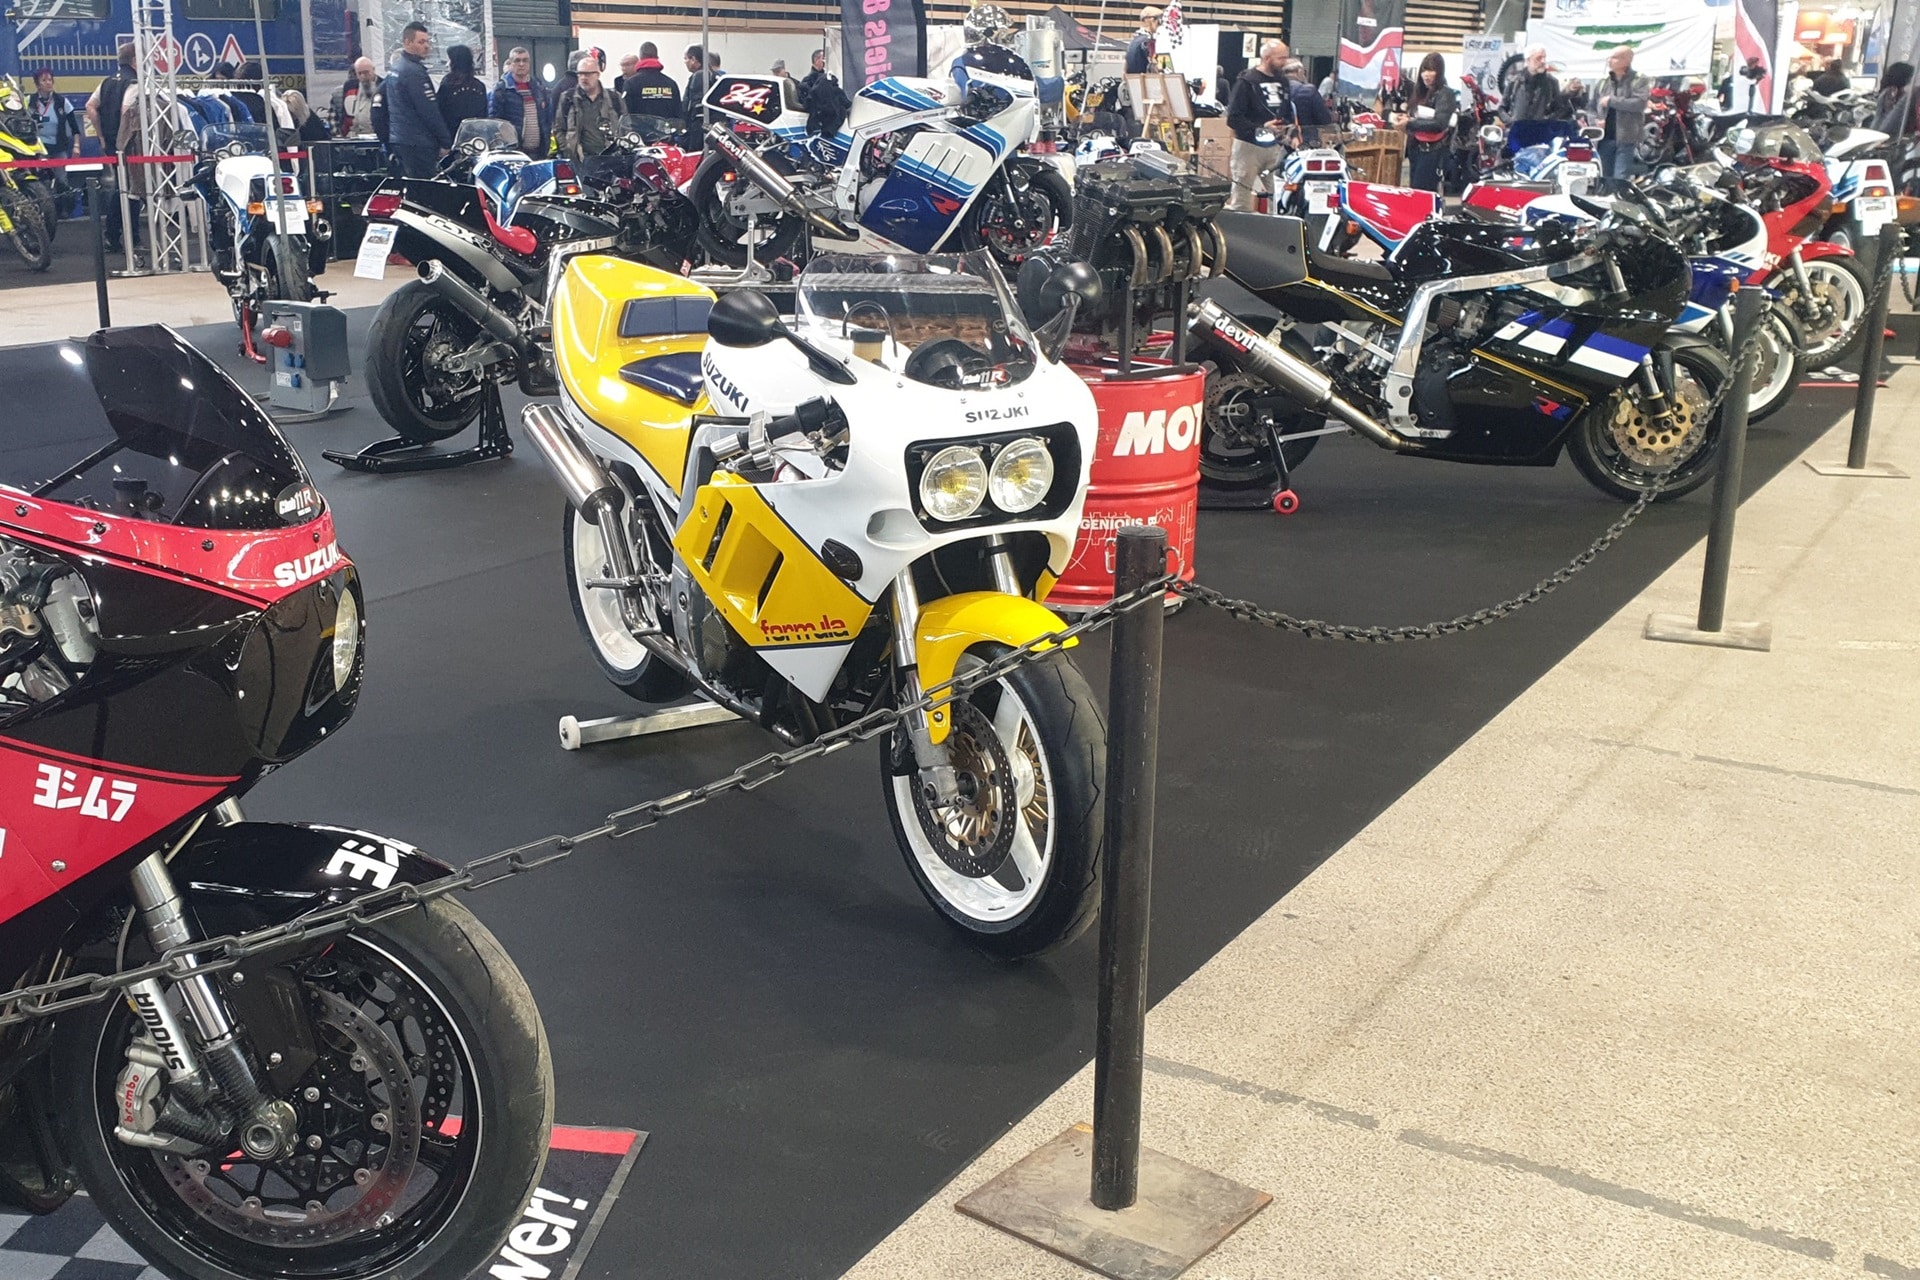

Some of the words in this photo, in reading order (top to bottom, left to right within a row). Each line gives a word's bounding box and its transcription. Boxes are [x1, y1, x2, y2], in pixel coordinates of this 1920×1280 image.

[718, 133, 747, 160] devil
[1214, 315, 1257, 351] devil
[703, 352, 749, 414] SUZUKI
[761, 615, 849, 642] formula
[134, 993, 186, 1071] SHOWA
[124, 1074, 140, 1123] brembo
